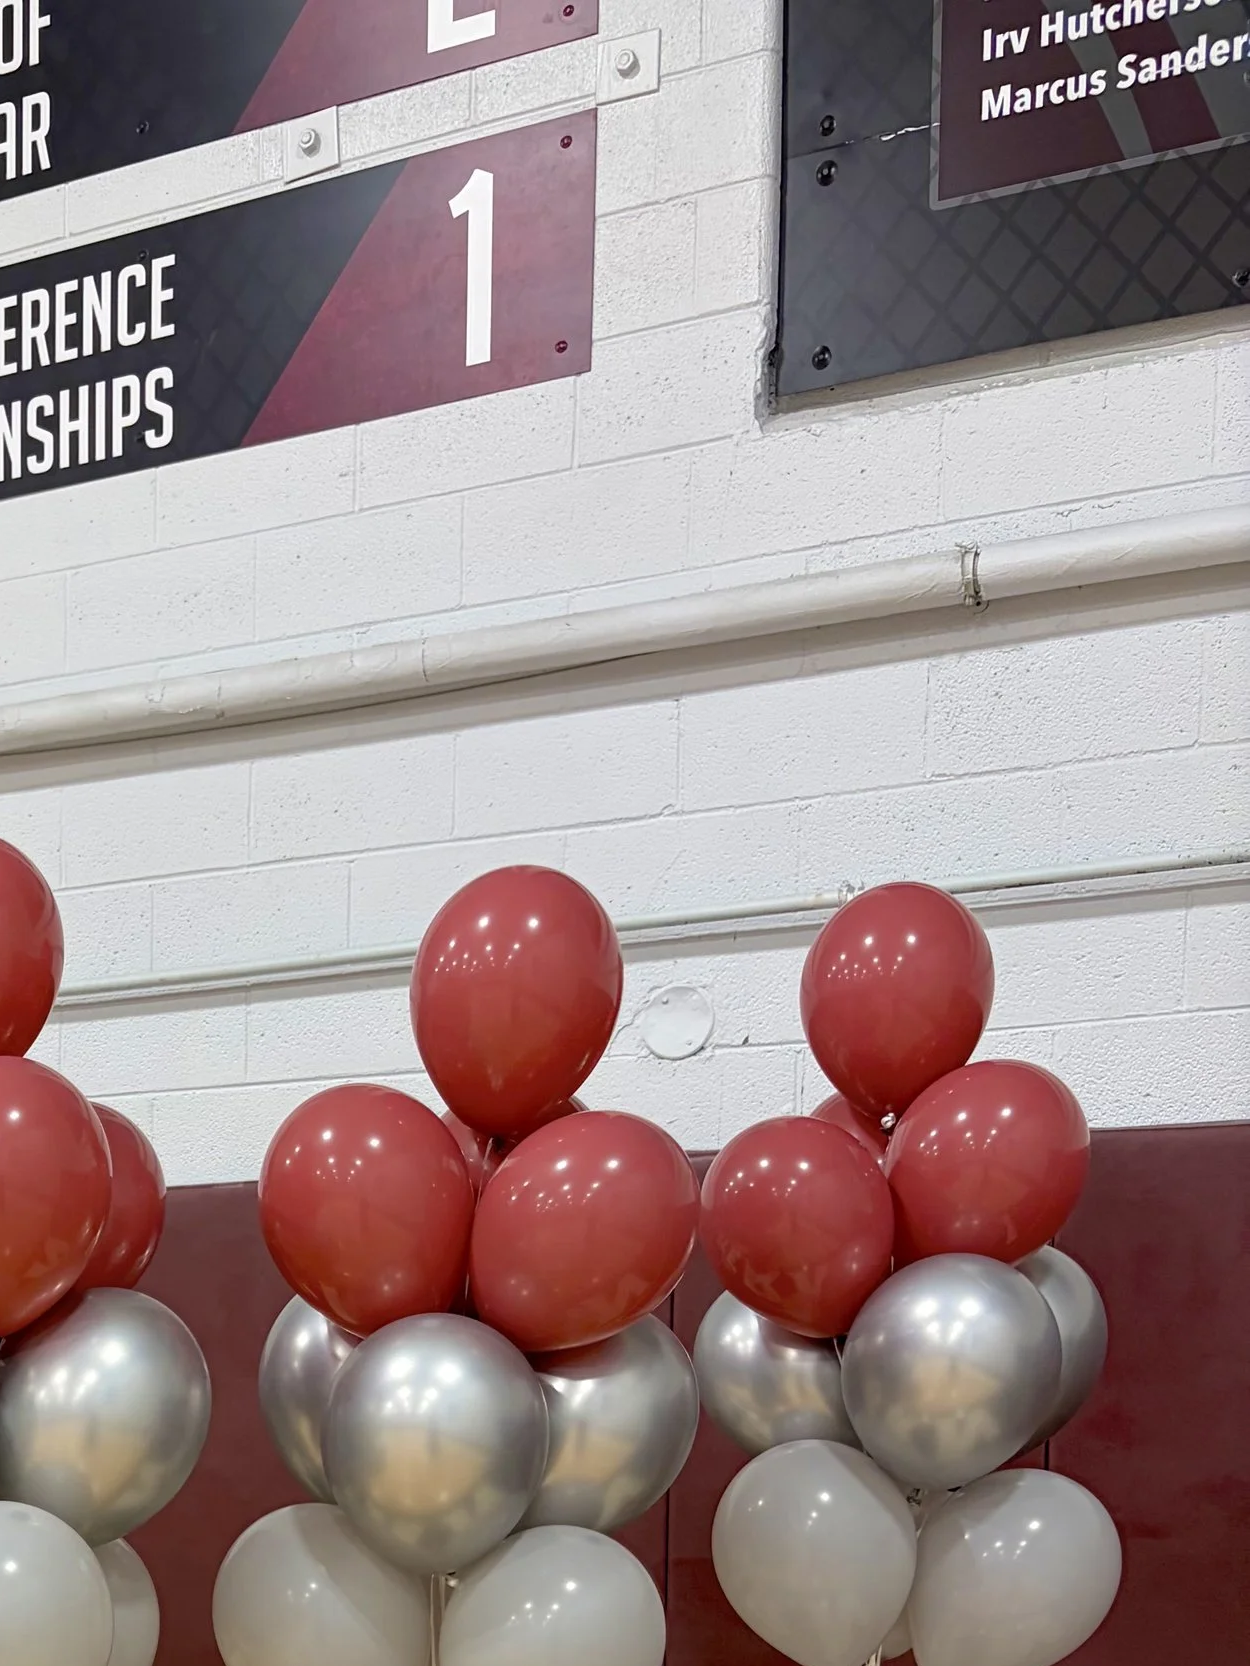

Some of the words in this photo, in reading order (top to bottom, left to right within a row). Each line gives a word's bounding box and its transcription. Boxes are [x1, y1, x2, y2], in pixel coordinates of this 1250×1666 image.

[982, 26, 1031, 61] Irv
[1040, 0, 1233, 47] Hutcher
[981, 69, 1107, 121] Marcus
[1116, 33, 1250, 90] Sander
[448, 168, 494, 367] 1
